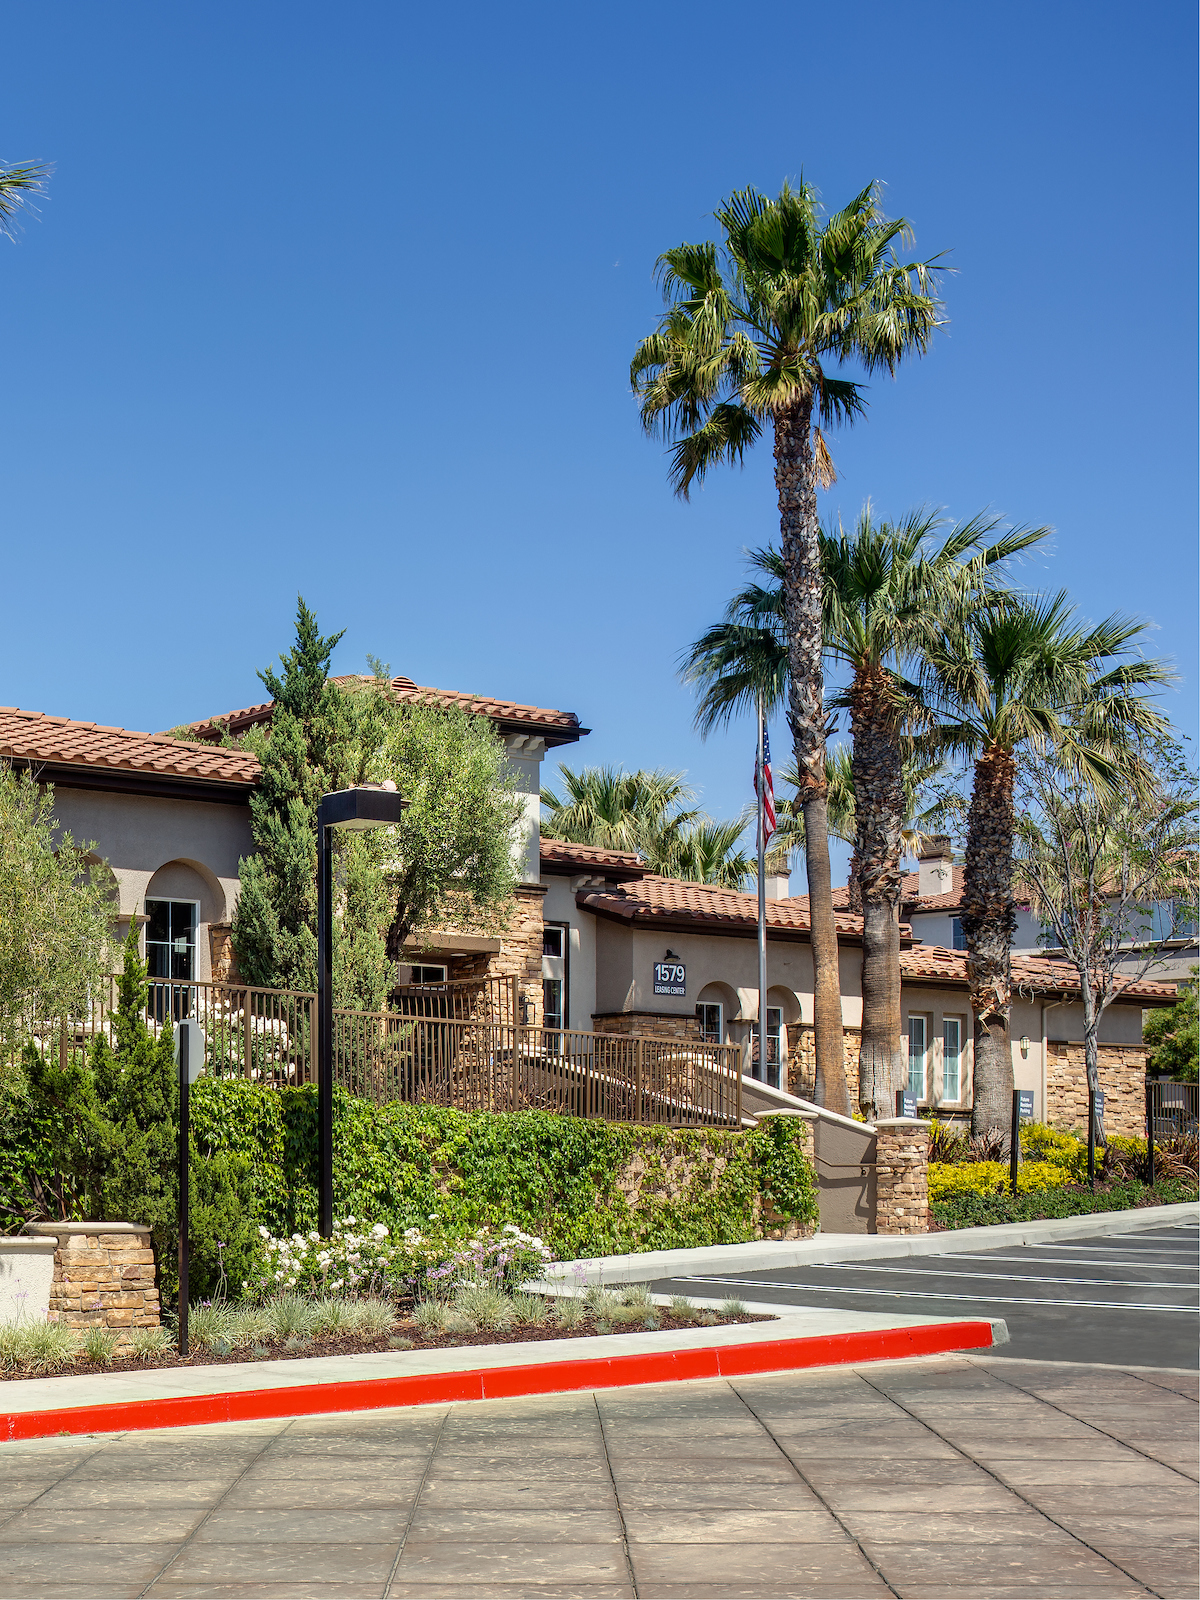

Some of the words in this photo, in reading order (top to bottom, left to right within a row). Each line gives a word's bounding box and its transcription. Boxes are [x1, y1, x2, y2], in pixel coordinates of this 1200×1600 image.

[655, 964, 685, 982] 1579
[655, 985, 670, 994] LEASING
[671, 986, 685, 995] CENTER
